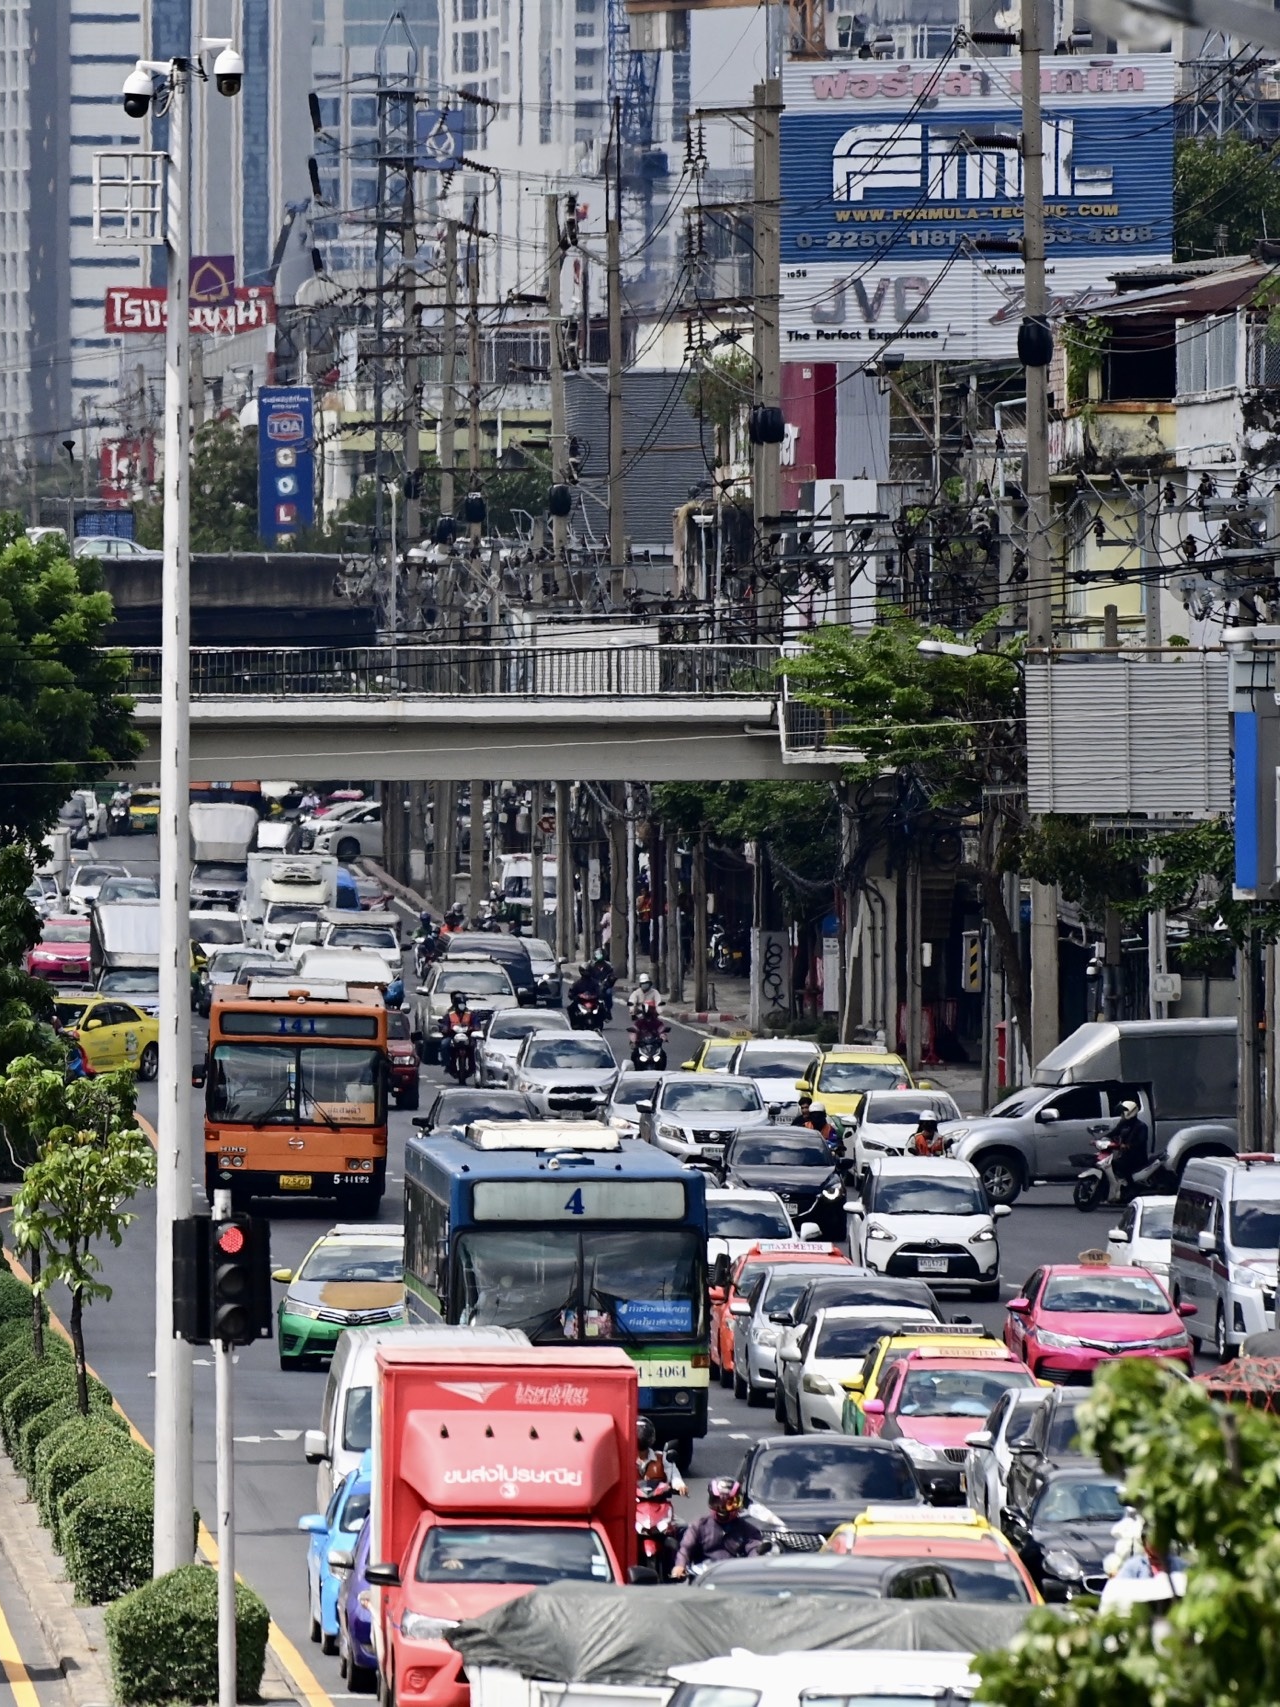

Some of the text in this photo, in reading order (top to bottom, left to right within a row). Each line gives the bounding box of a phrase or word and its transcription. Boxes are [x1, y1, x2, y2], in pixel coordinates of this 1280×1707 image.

[812, 276, 930, 324] JVC
[787, 328, 939, 342] The Perfect Experience
[271, 419, 300, 433] TOA
[278, 1017, 317, 1034] 141
[564, 1187, 585, 1215] 4
